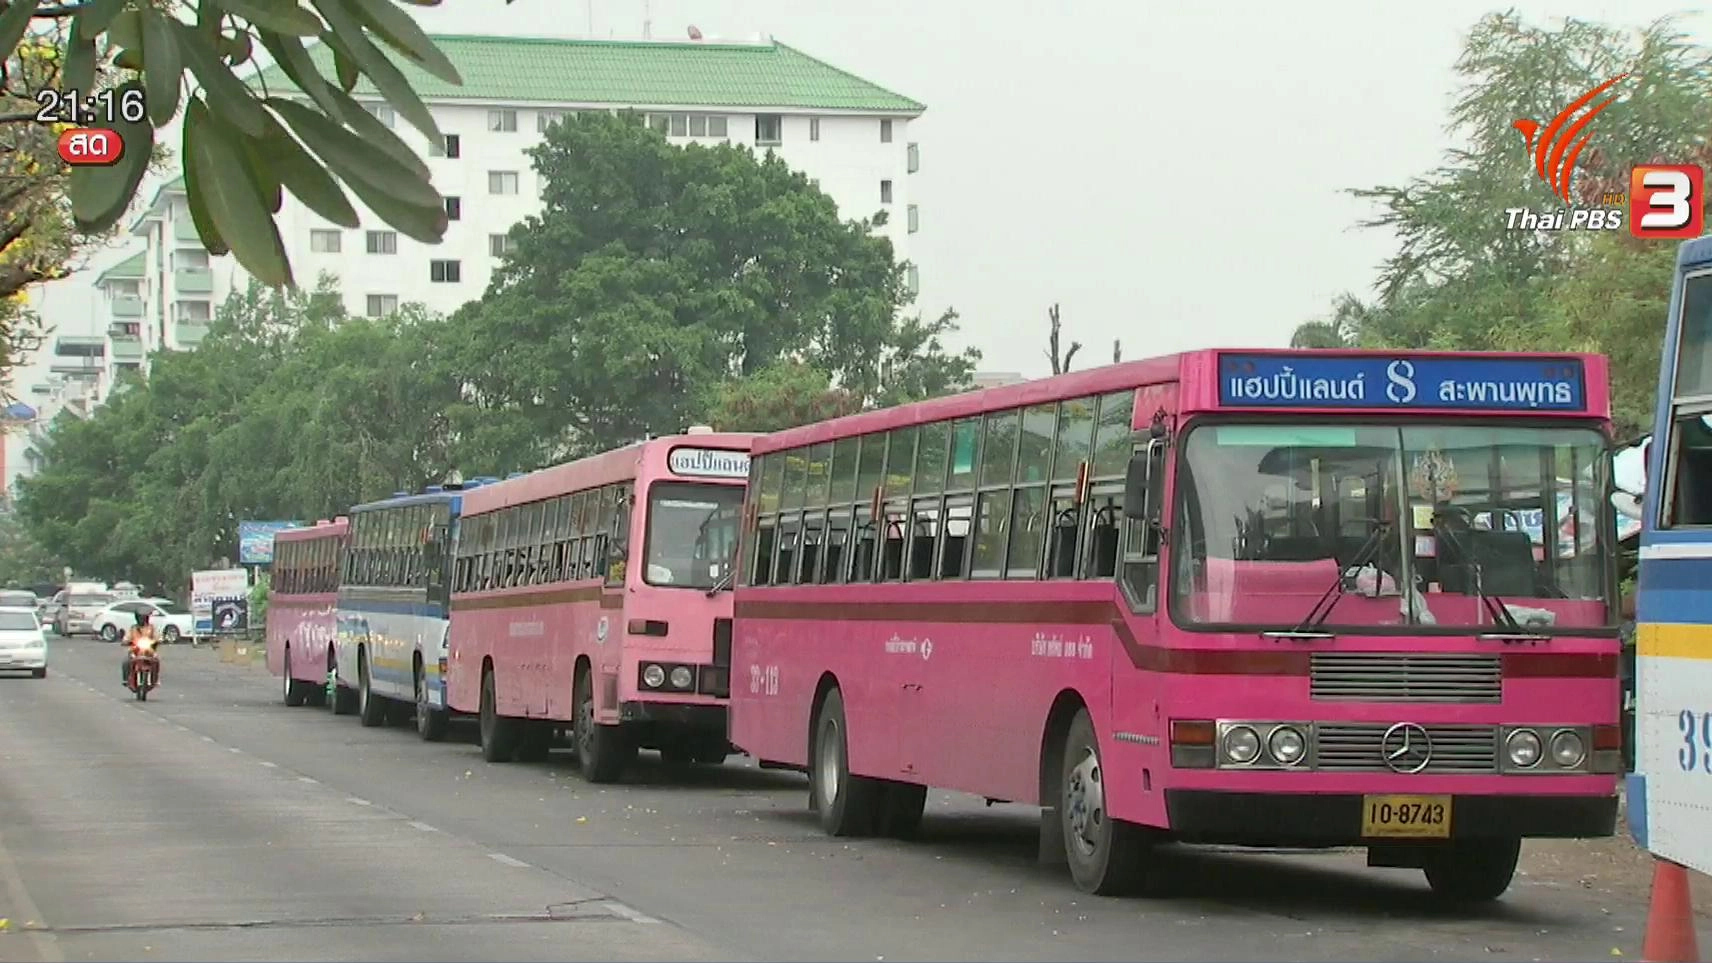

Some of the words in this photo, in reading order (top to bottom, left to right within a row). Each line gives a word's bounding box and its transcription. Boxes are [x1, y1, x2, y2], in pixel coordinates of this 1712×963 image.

[1230, 366, 1366, 400] แฮปปี้แลนด์
[1385, 359, 1417, 404] 8
[1439, 379, 1573, 408] สะพานพุทธ
[1371, 803, 1445, 825] 10-8743
